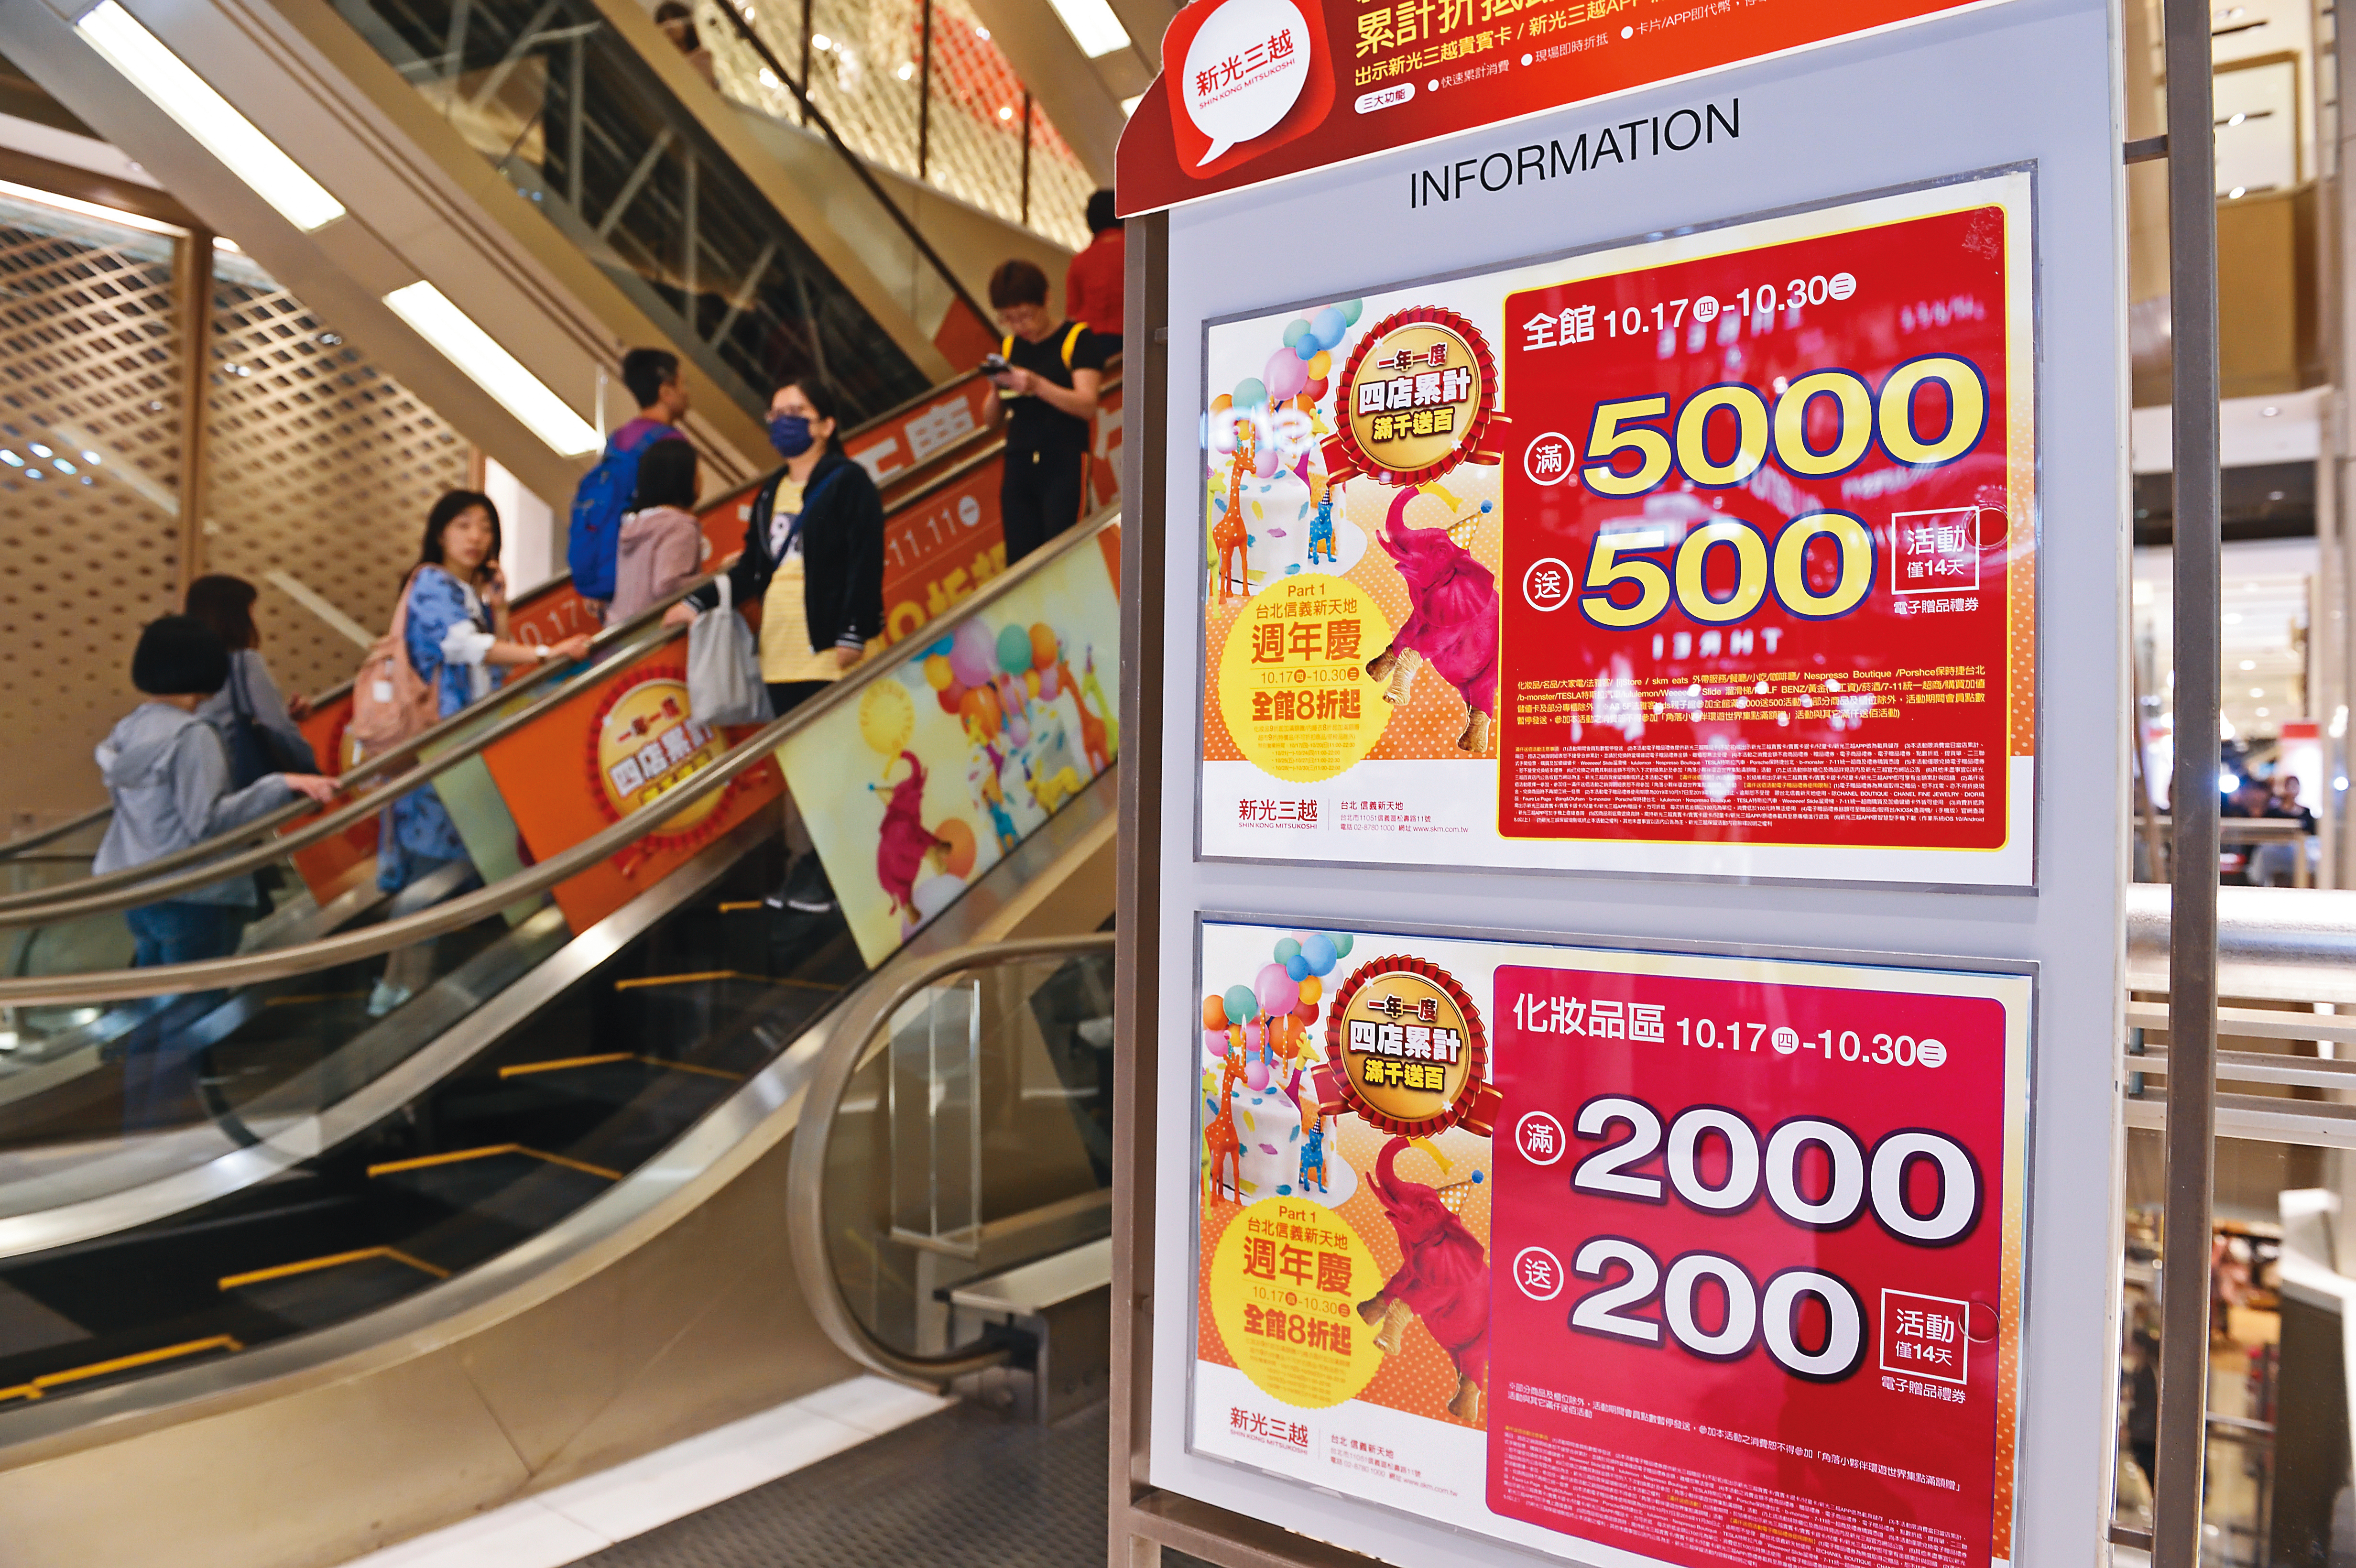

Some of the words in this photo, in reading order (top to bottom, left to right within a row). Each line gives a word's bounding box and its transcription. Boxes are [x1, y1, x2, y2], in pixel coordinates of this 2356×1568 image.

[1356, 0, 1556, 58] 累計折
[1196, 29, 1293, 96] 新光三越
[1355, 26, 1512, 87] 出示新光三越貴賓卡
[1535, 32, 1608, 63] 現場即時折抵
[1199, 97, 1218, 109] SHIN
[1219, 84, 1242, 99] KONG
[1244, 58, 1295, 87] MITSUKOSHI
[1441, 59, 1509, 88] 快速累計消費
[1363, 88, 1406, 109] 三大功能
[1411, 98, 1739, 208] INFORMATION
[1523, 305, 1595, 352] 全館
[1377, 342, 1448, 371] 一年一度
[1358, 367, 1472, 415] 四店累計
[1372, 407, 1455, 442] 滿千送百
[1583, 352, 1990, 500] 5000
[1907, 525, 1965, 555] 活動
[1578, 508, 1878, 631] 500
[1907, 559, 1964, 578] 僅14天
[1288, 585, 1315, 597] Part
[1320, 583, 1325, 595] 1
[1894, 597, 1979, 615] 電子贈品禮券
[1256, 598, 1357, 619] 台北信義新天地
[1251, 619, 1362, 664] 週年慶
[1702, 687, 1722, 696] Slide
[1804, 672, 1848, 681] Nespresso
[1853, 670, 1892, 679] Boutique
[1252, 688, 1361, 722] 全館8折起
[1239, 798, 1318, 821] 新光三越
[1341, 801, 1357, 810] 台北
[1361, 801, 1403, 810] 信義新天地
[1367, 993, 1438, 1021] 一年一度
[1513, 992, 1666, 1044] 化妝品區
[1349, 1019, 1462, 1064] 四店累計
[1364, 1057, 1445, 1092] 滿千送百
[1571, 1093, 1984, 1249] 2000
[1279, 1205, 1305, 1221] Part
[1310, 1211, 1316, 1223] 1
[1248, 1216, 1348, 1251] 台北信義新天地
[1243, 1236, 1352, 1297] 週年慶
[1568, 1234, 1867, 1384] 200
[1896, 1308, 1954, 1343] 活動
[1244, 1303, 1352, 1356] 全館8折起
[1896, 1340, 1952, 1366] 僅14天
[1881, 1375, 1966, 1404] 電子贈品禮券
[1230, 1428, 1245, 1437] SHIN
[1246, 1434, 1265, 1444] KONG
[1266, 1439, 1308, 1455] MITSUKOSHI
[1231, 1406, 1308, 1448] 新光三越
[1331, 1434, 1347, 1447] 台北
